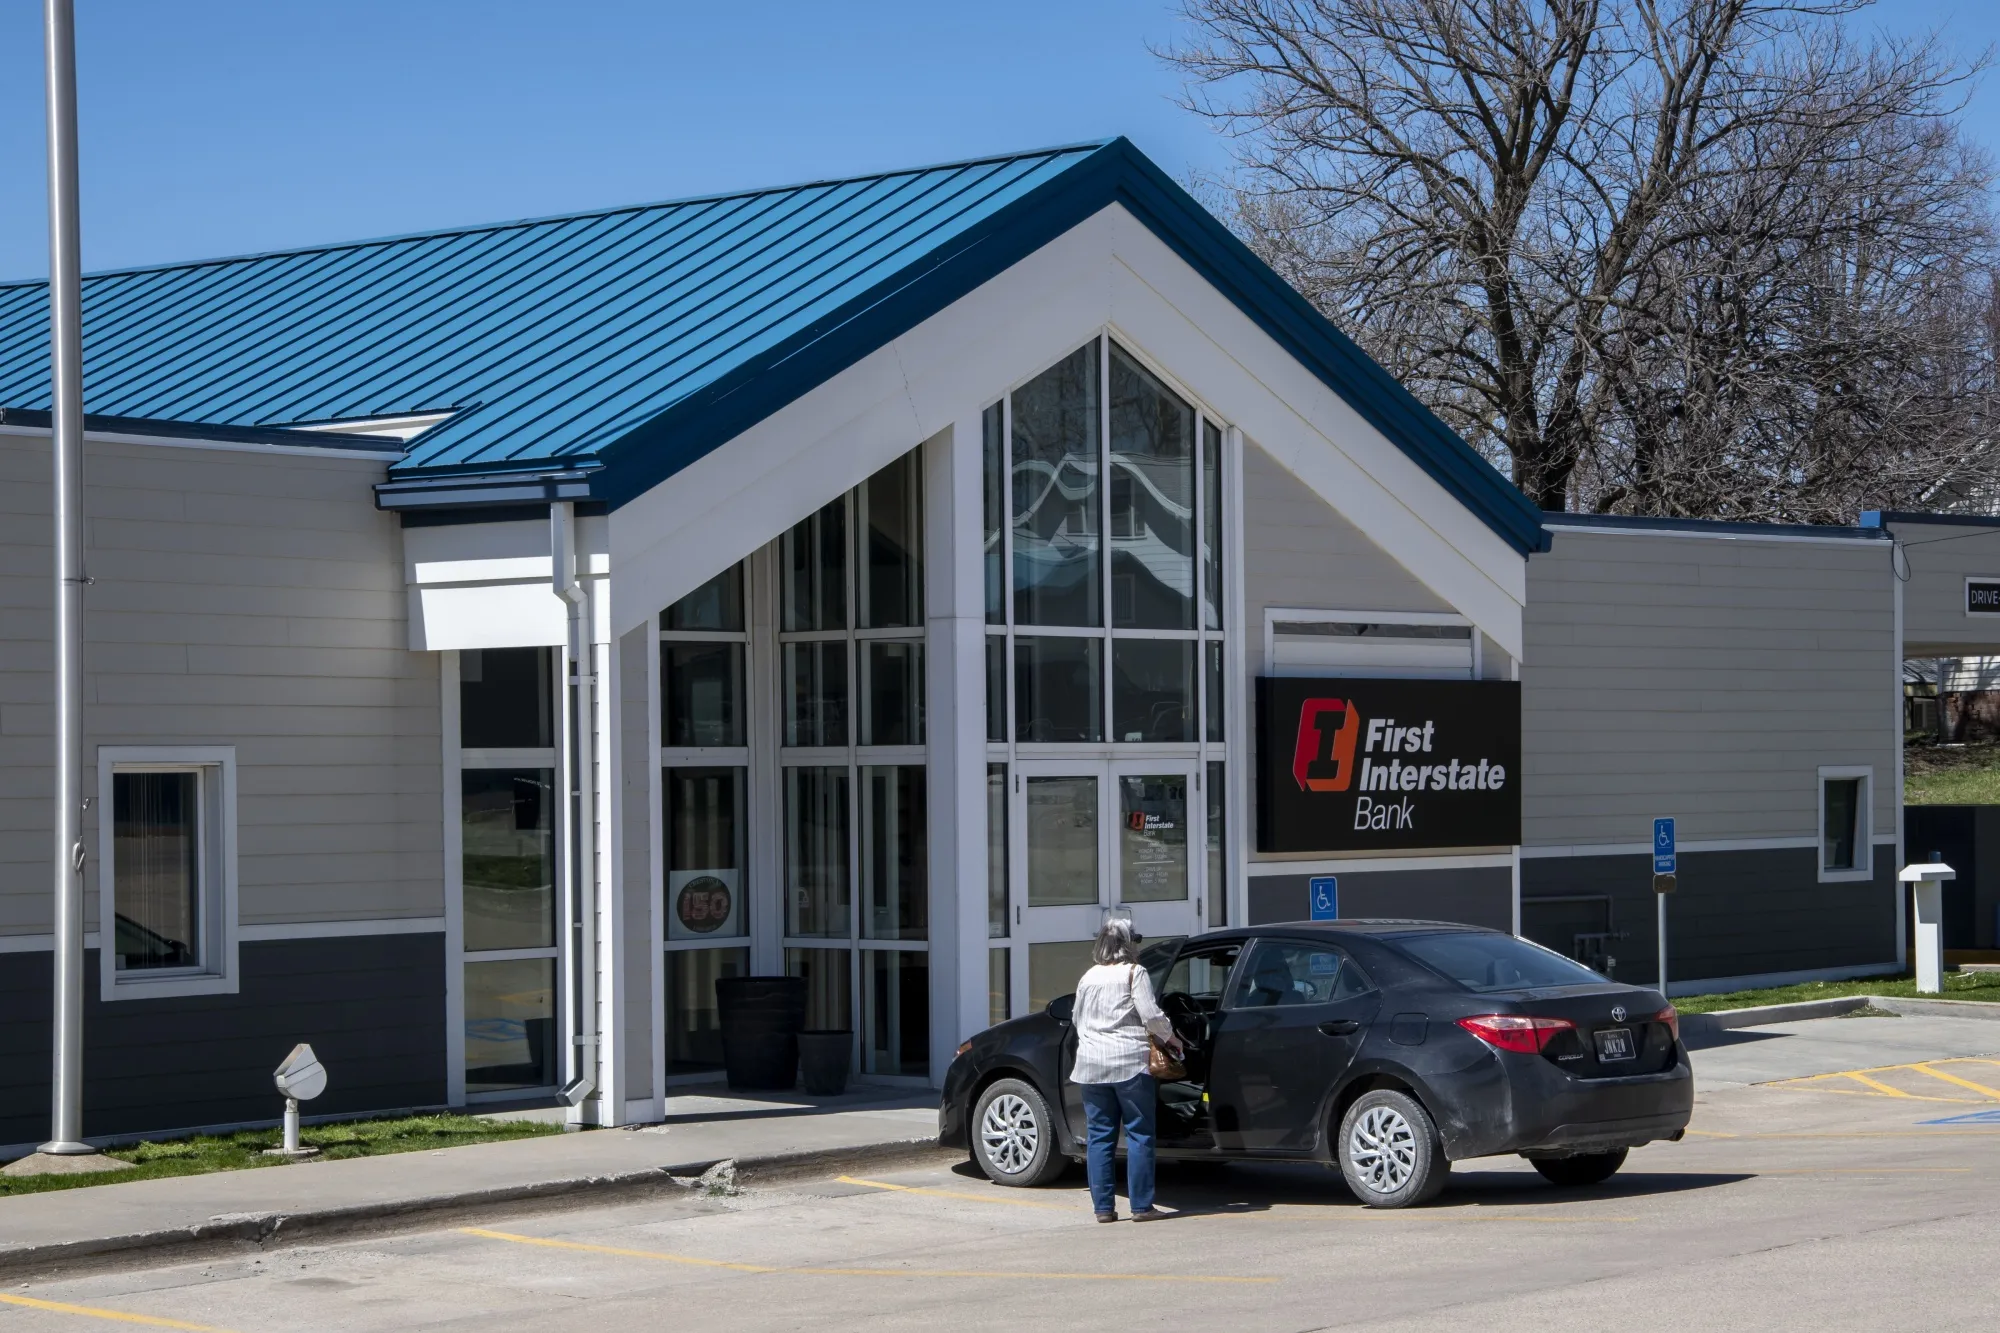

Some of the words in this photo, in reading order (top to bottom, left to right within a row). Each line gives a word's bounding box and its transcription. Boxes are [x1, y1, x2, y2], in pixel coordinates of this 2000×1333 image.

[1365, 718, 1435, 752] First
[1359, 757, 1506, 791] Interstate
[1354, 796, 1415, 830] Bank
[683, 892, 728, 920] 150
